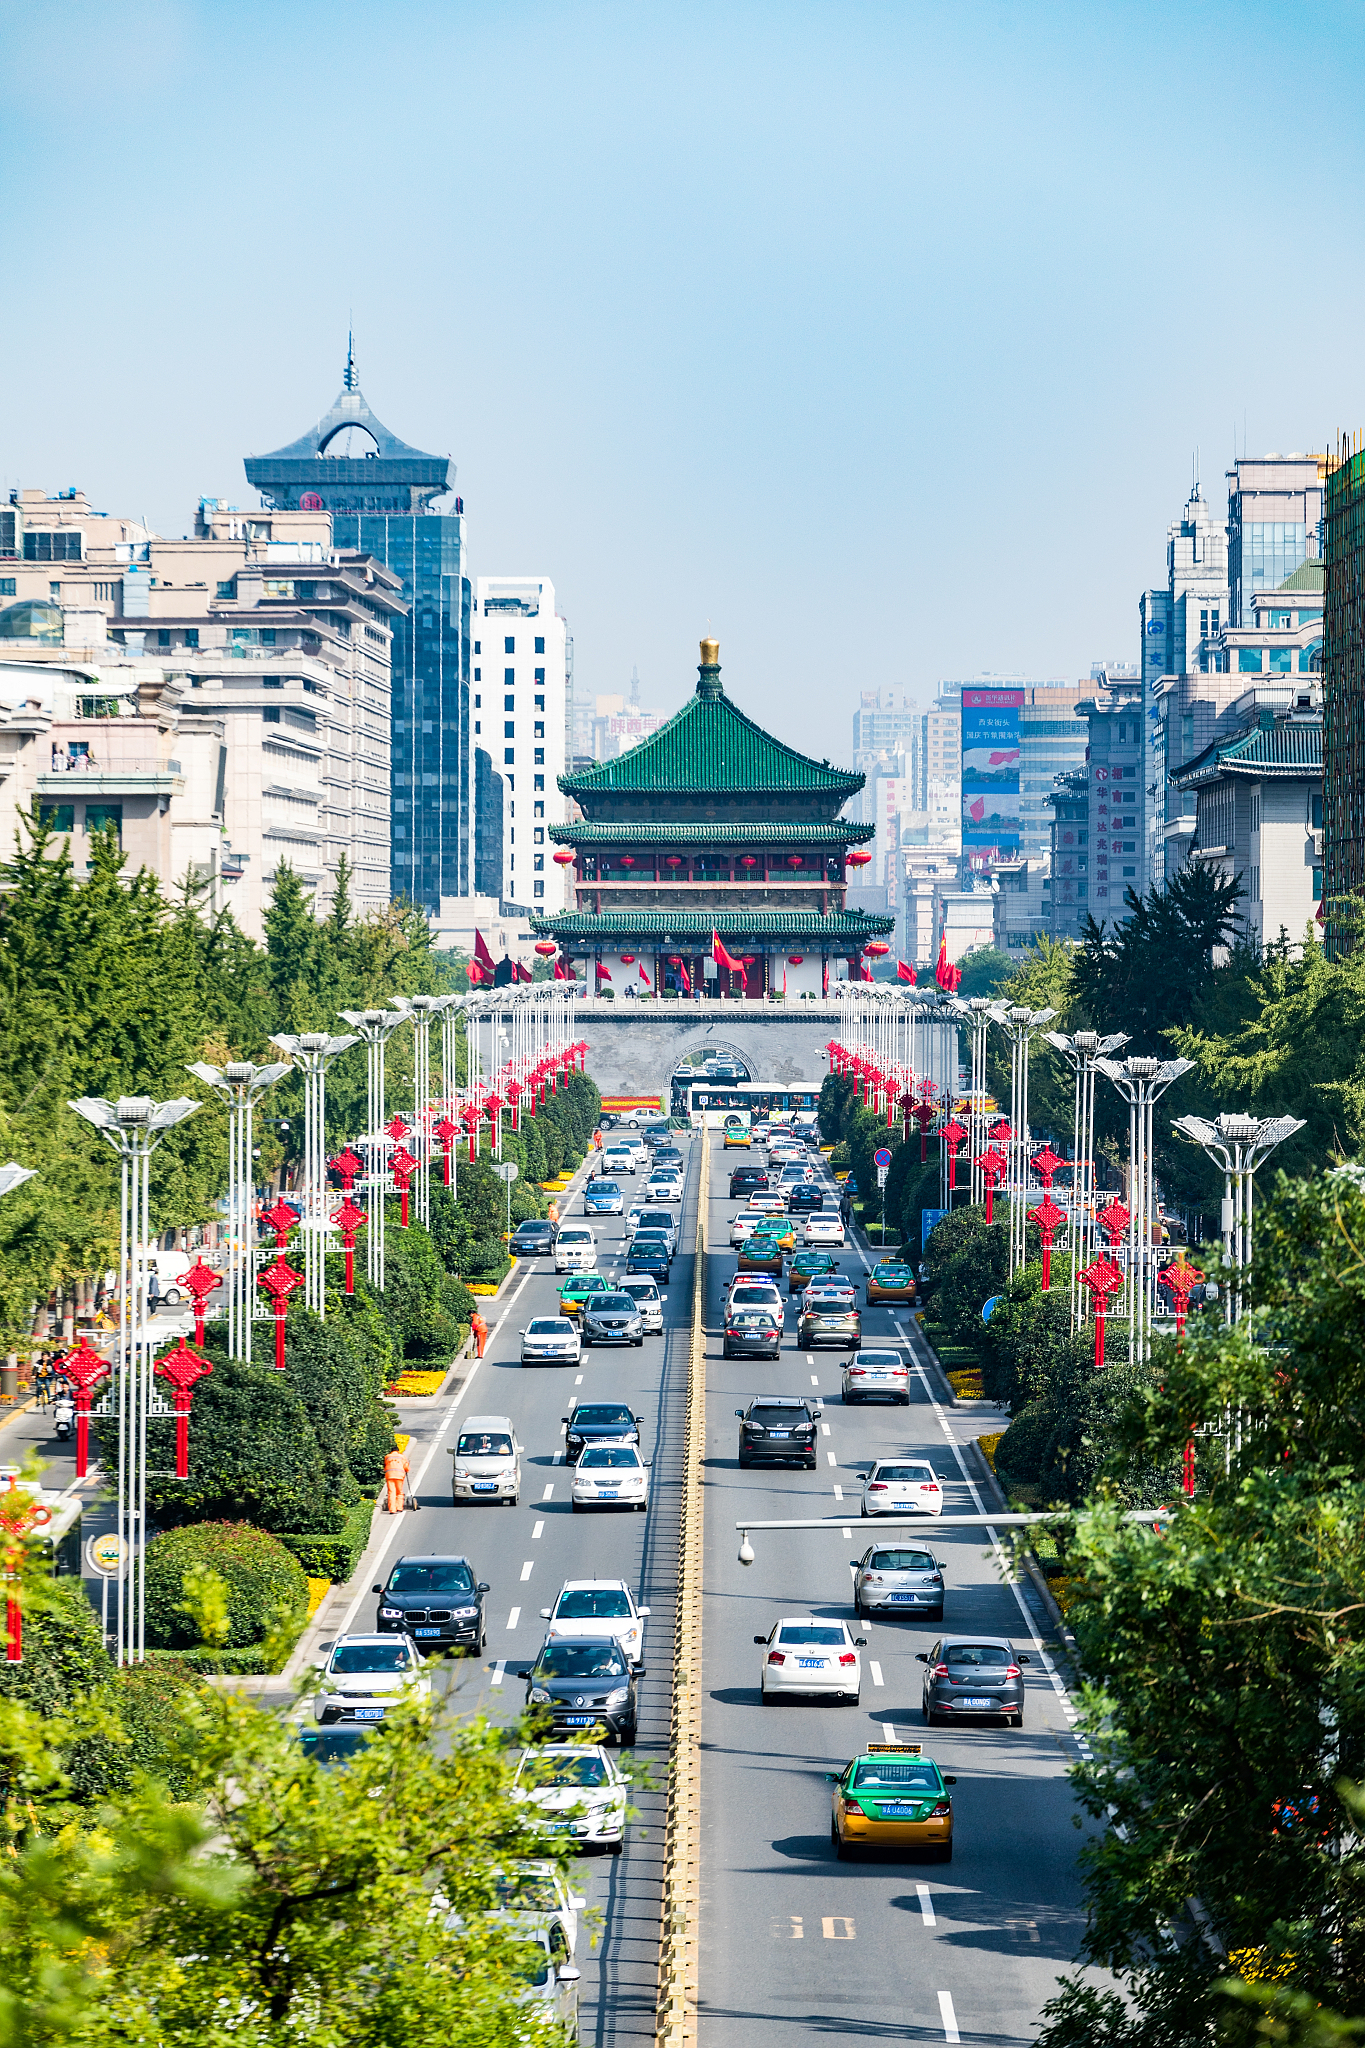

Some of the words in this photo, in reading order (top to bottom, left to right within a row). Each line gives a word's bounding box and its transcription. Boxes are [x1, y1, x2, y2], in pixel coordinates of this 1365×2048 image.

[979, 718, 1010, 727] 西安街头
[1096, 786, 1108, 898] 华美达兆瑞酒店
[1111, 767, 1124, 854] 招商银行
